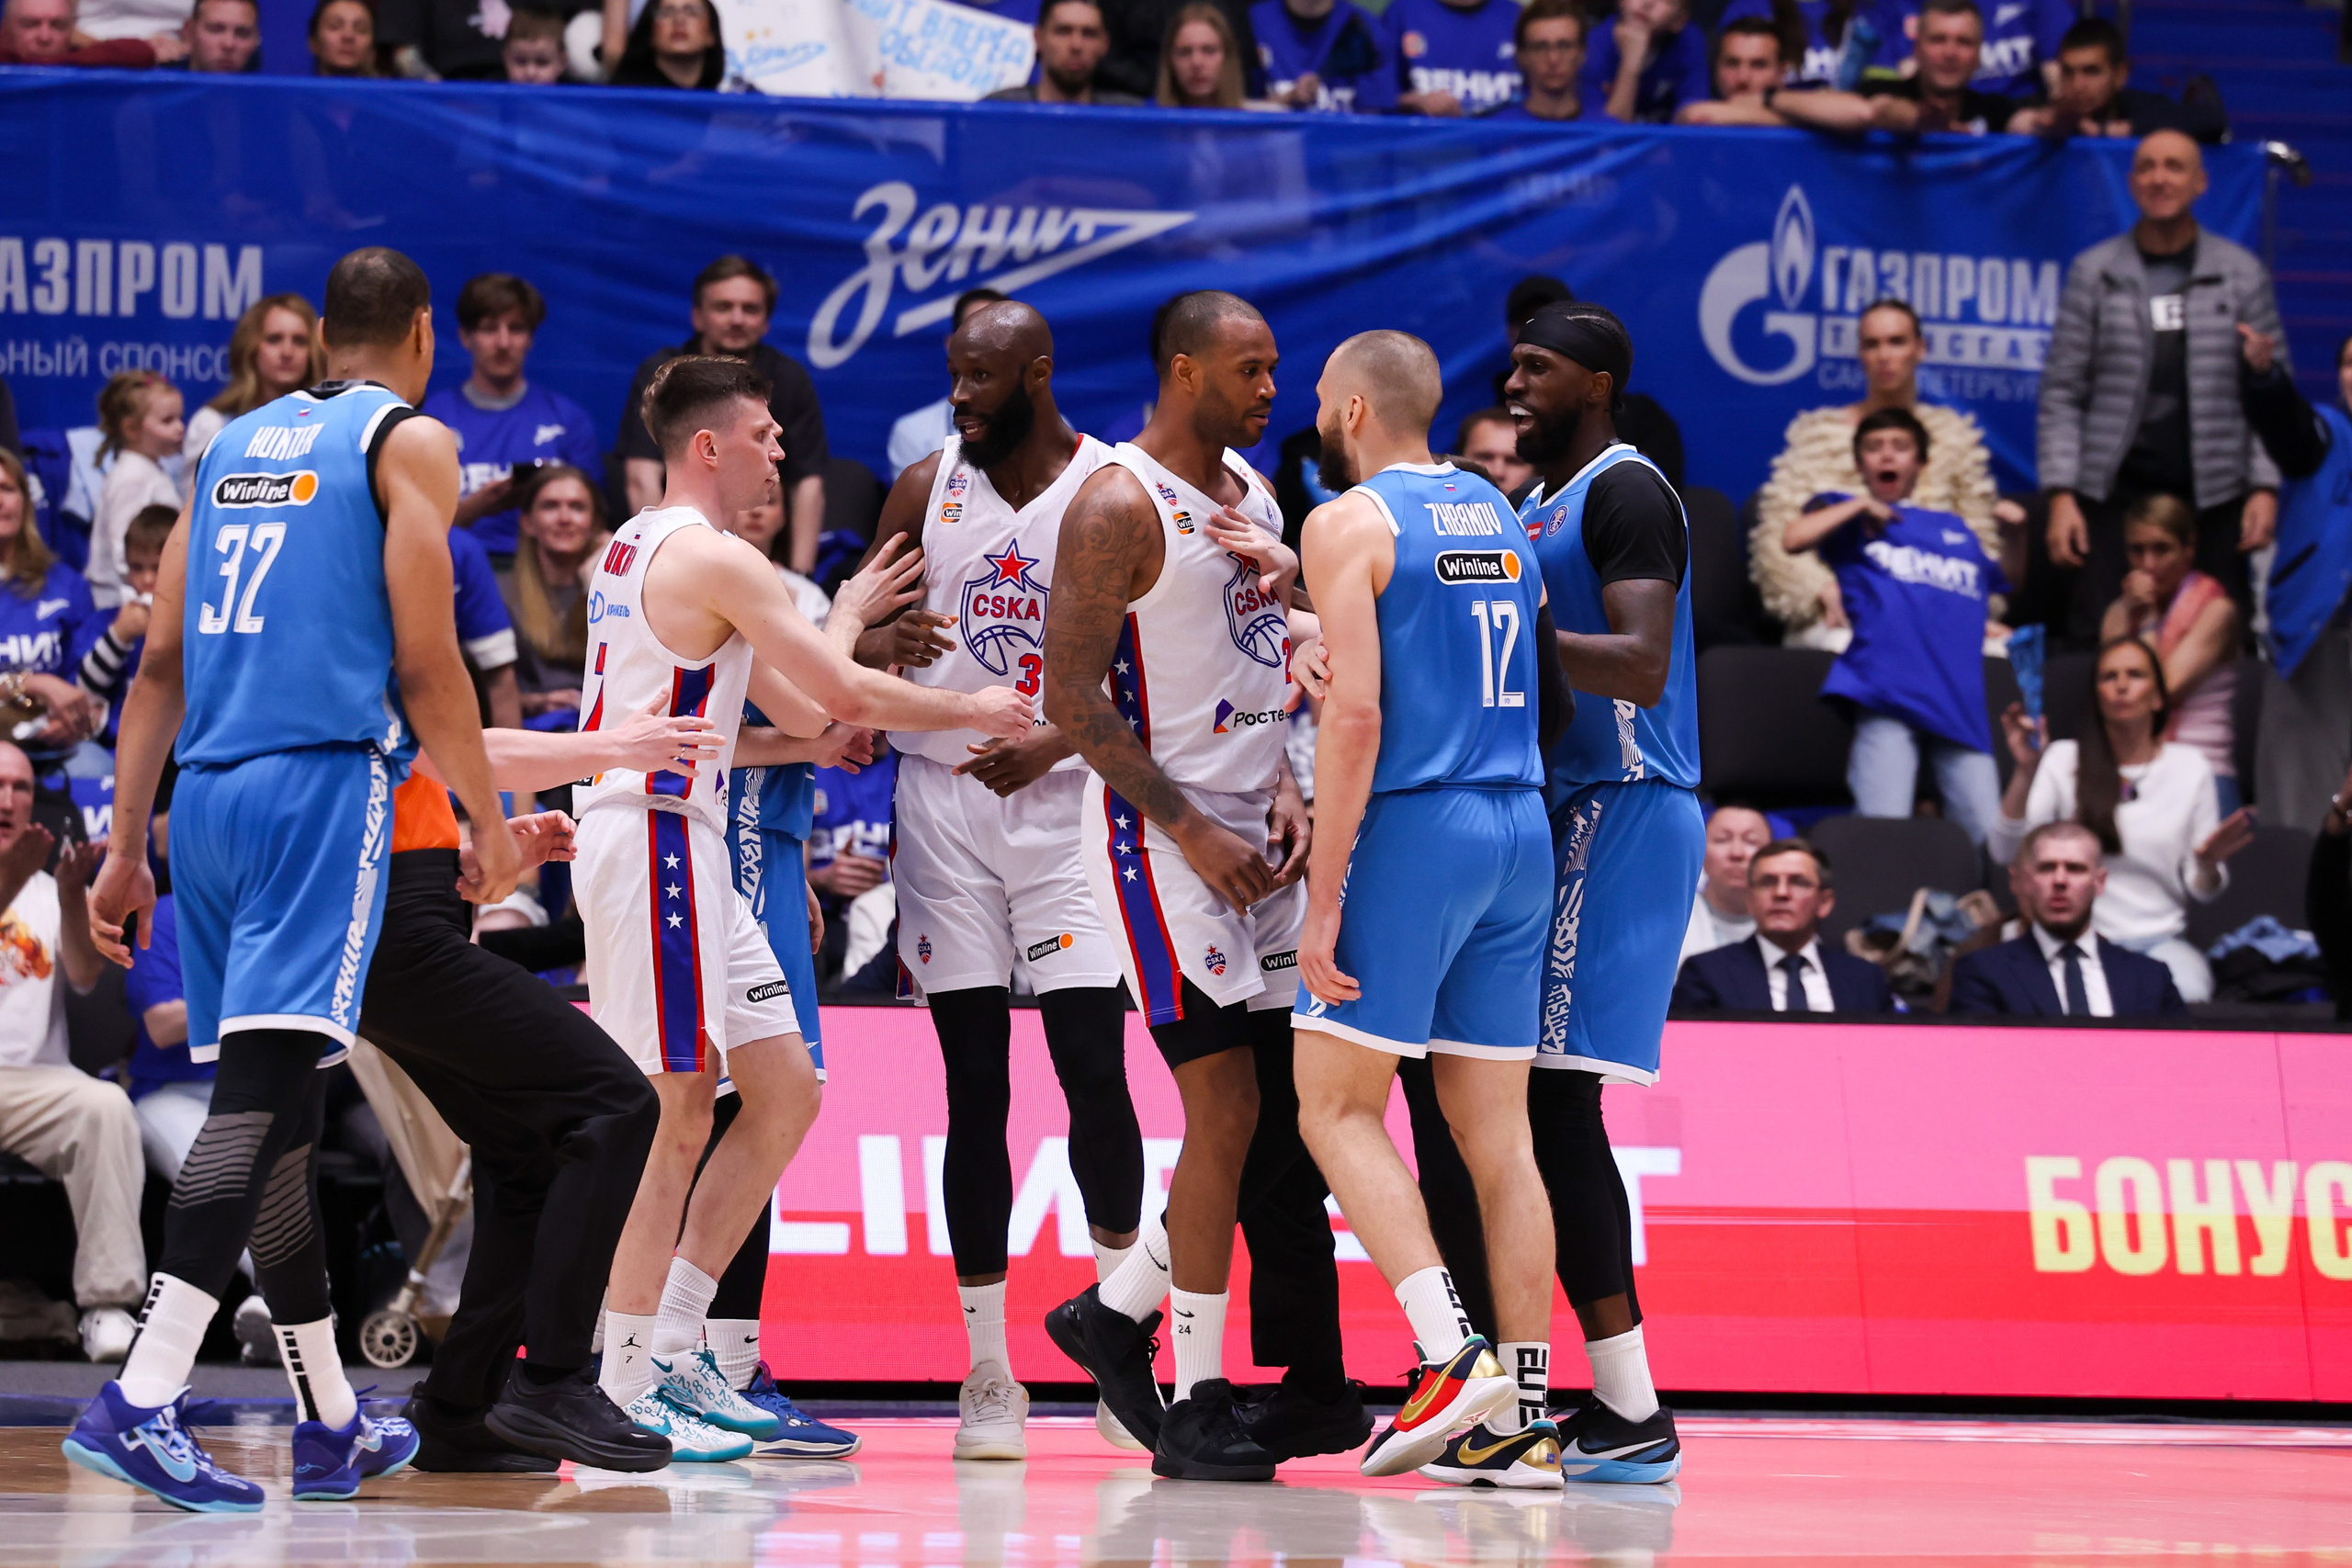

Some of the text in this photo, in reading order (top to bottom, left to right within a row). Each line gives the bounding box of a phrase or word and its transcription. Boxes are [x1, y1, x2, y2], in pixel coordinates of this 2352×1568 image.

[1822, 245, 2059, 325] ГАЗПРОМ
[0, 333, 89, 378] НЫЙ
[244, 423, 324, 460] HUNTER
[222, 479, 289, 502] Winline
[945, 509, 962, 518] Win
[1177, 519, 1193, 528] Win
[1423, 502, 1503, 536] ZHBANOV
[198, 521, 288, 635] 32
[1442, 558, 1500, 577] Winline
[972, 593, 1041, 622] CSKA
[1471, 600, 1525, 708] 12
[1028, 940, 1058, 960] Winline
[1206, 954, 1226, 966] CSKA
[1178, 1324, 1192, 1336] 24
